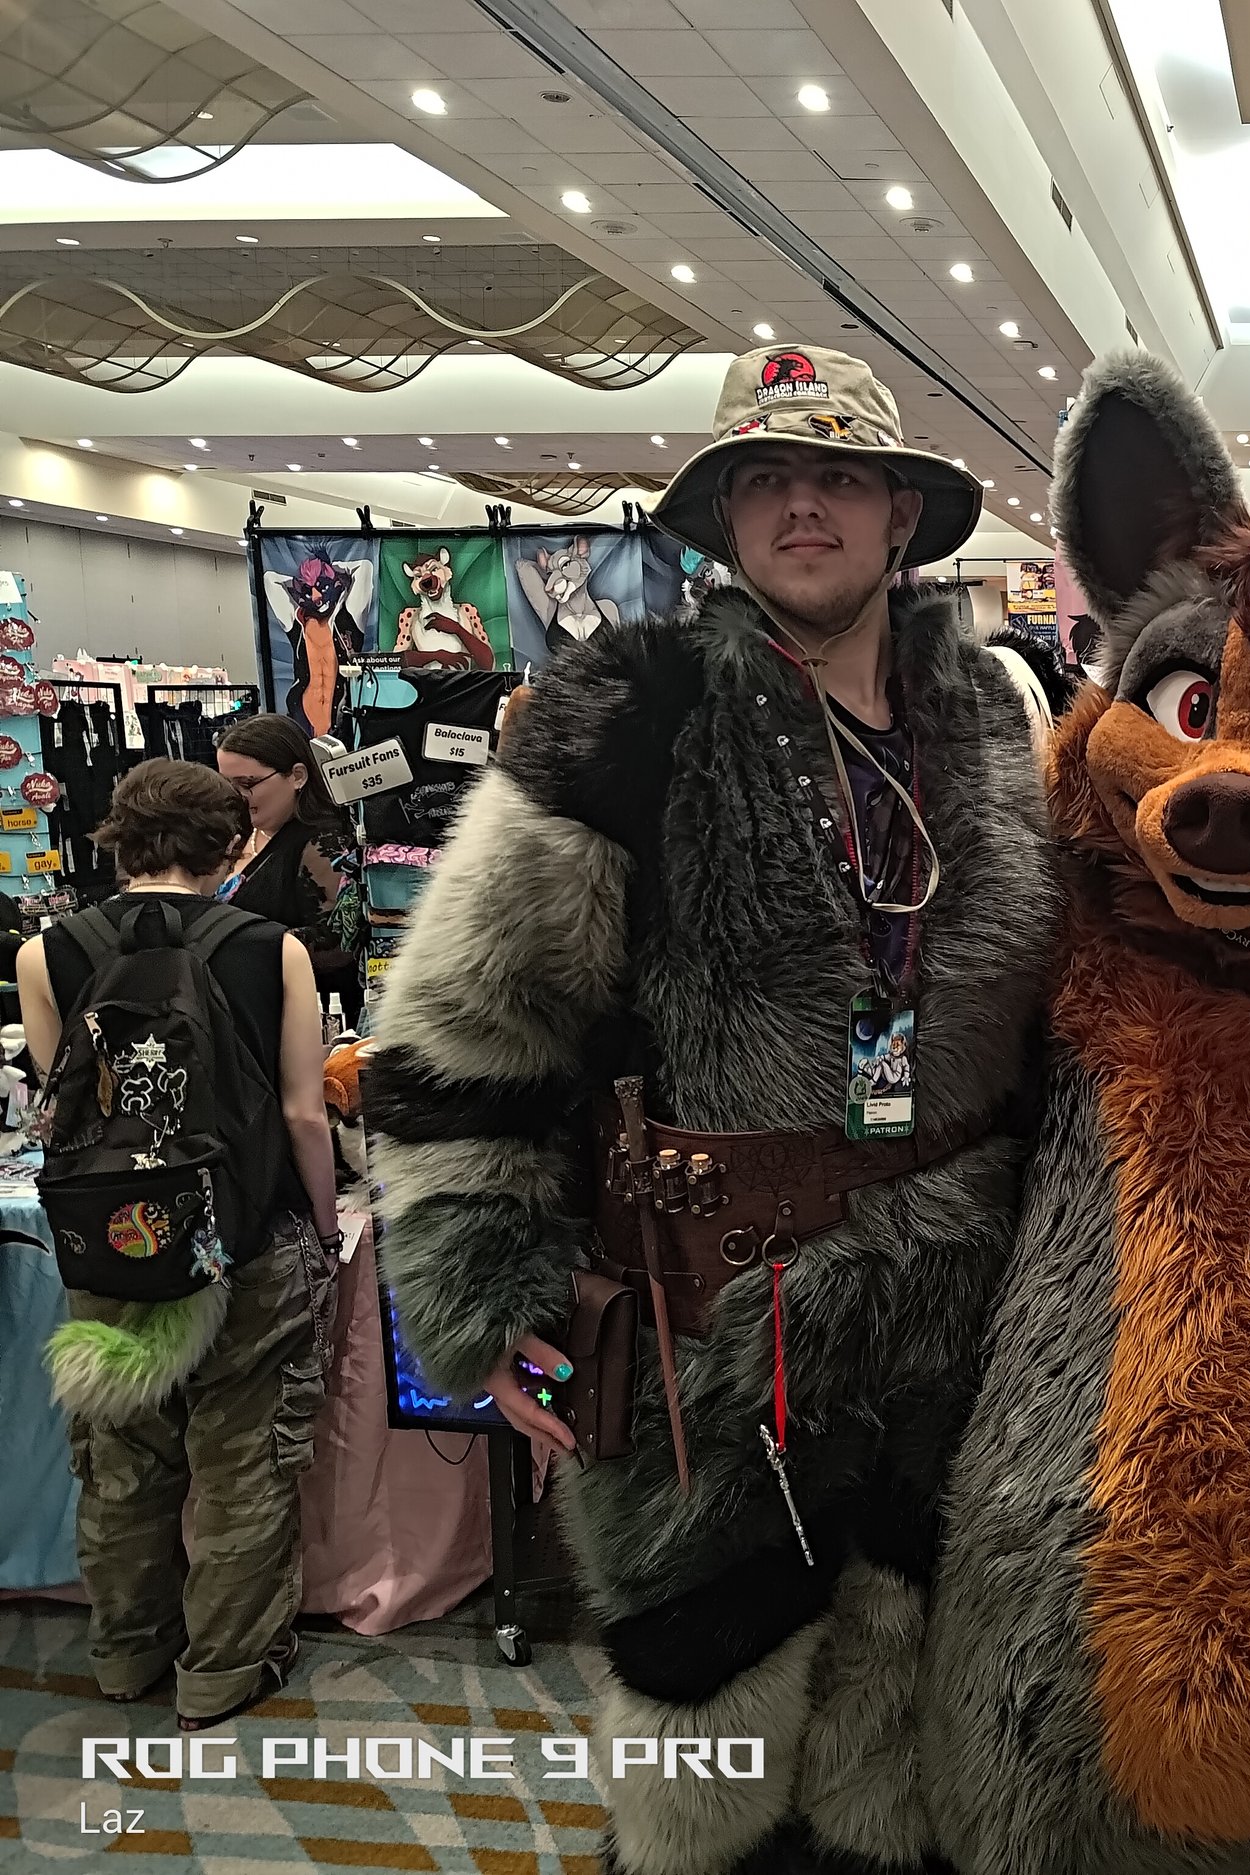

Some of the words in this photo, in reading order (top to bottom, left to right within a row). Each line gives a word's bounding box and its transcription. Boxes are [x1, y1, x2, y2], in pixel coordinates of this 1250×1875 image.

[757, 382, 793, 400] DRAGON
[434, 728, 483, 743] Balaclava
[449, 746, 465, 758] $15
[328, 754, 371, 780] Fursuit
[371, 747, 400, 766] Fans
[361, 774, 383, 790] $35
[870, 1125, 904, 1135] PATRON
